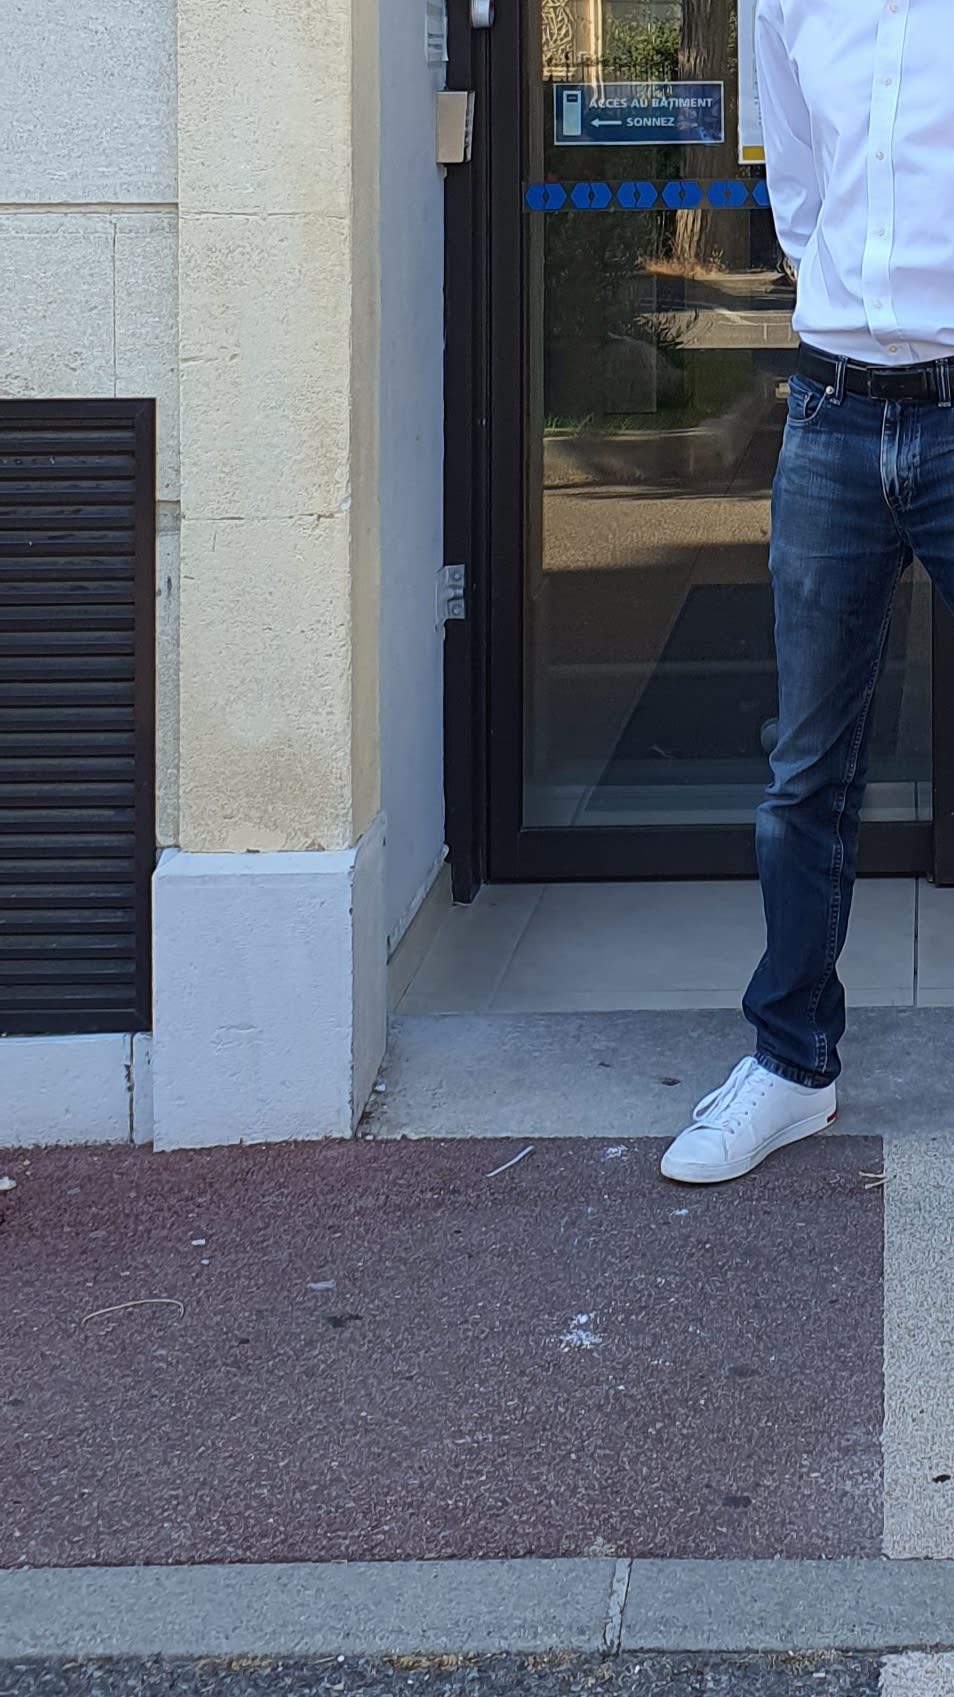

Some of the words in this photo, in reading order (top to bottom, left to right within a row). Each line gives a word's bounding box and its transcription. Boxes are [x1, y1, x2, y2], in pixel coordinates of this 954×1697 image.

[588, 96, 627, 108] ACCÈS
[631, 98, 648, 108] AU
[652, 95, 713, 108] BÂTIMENT
[626, 117, 675, 127] SONNEZ
